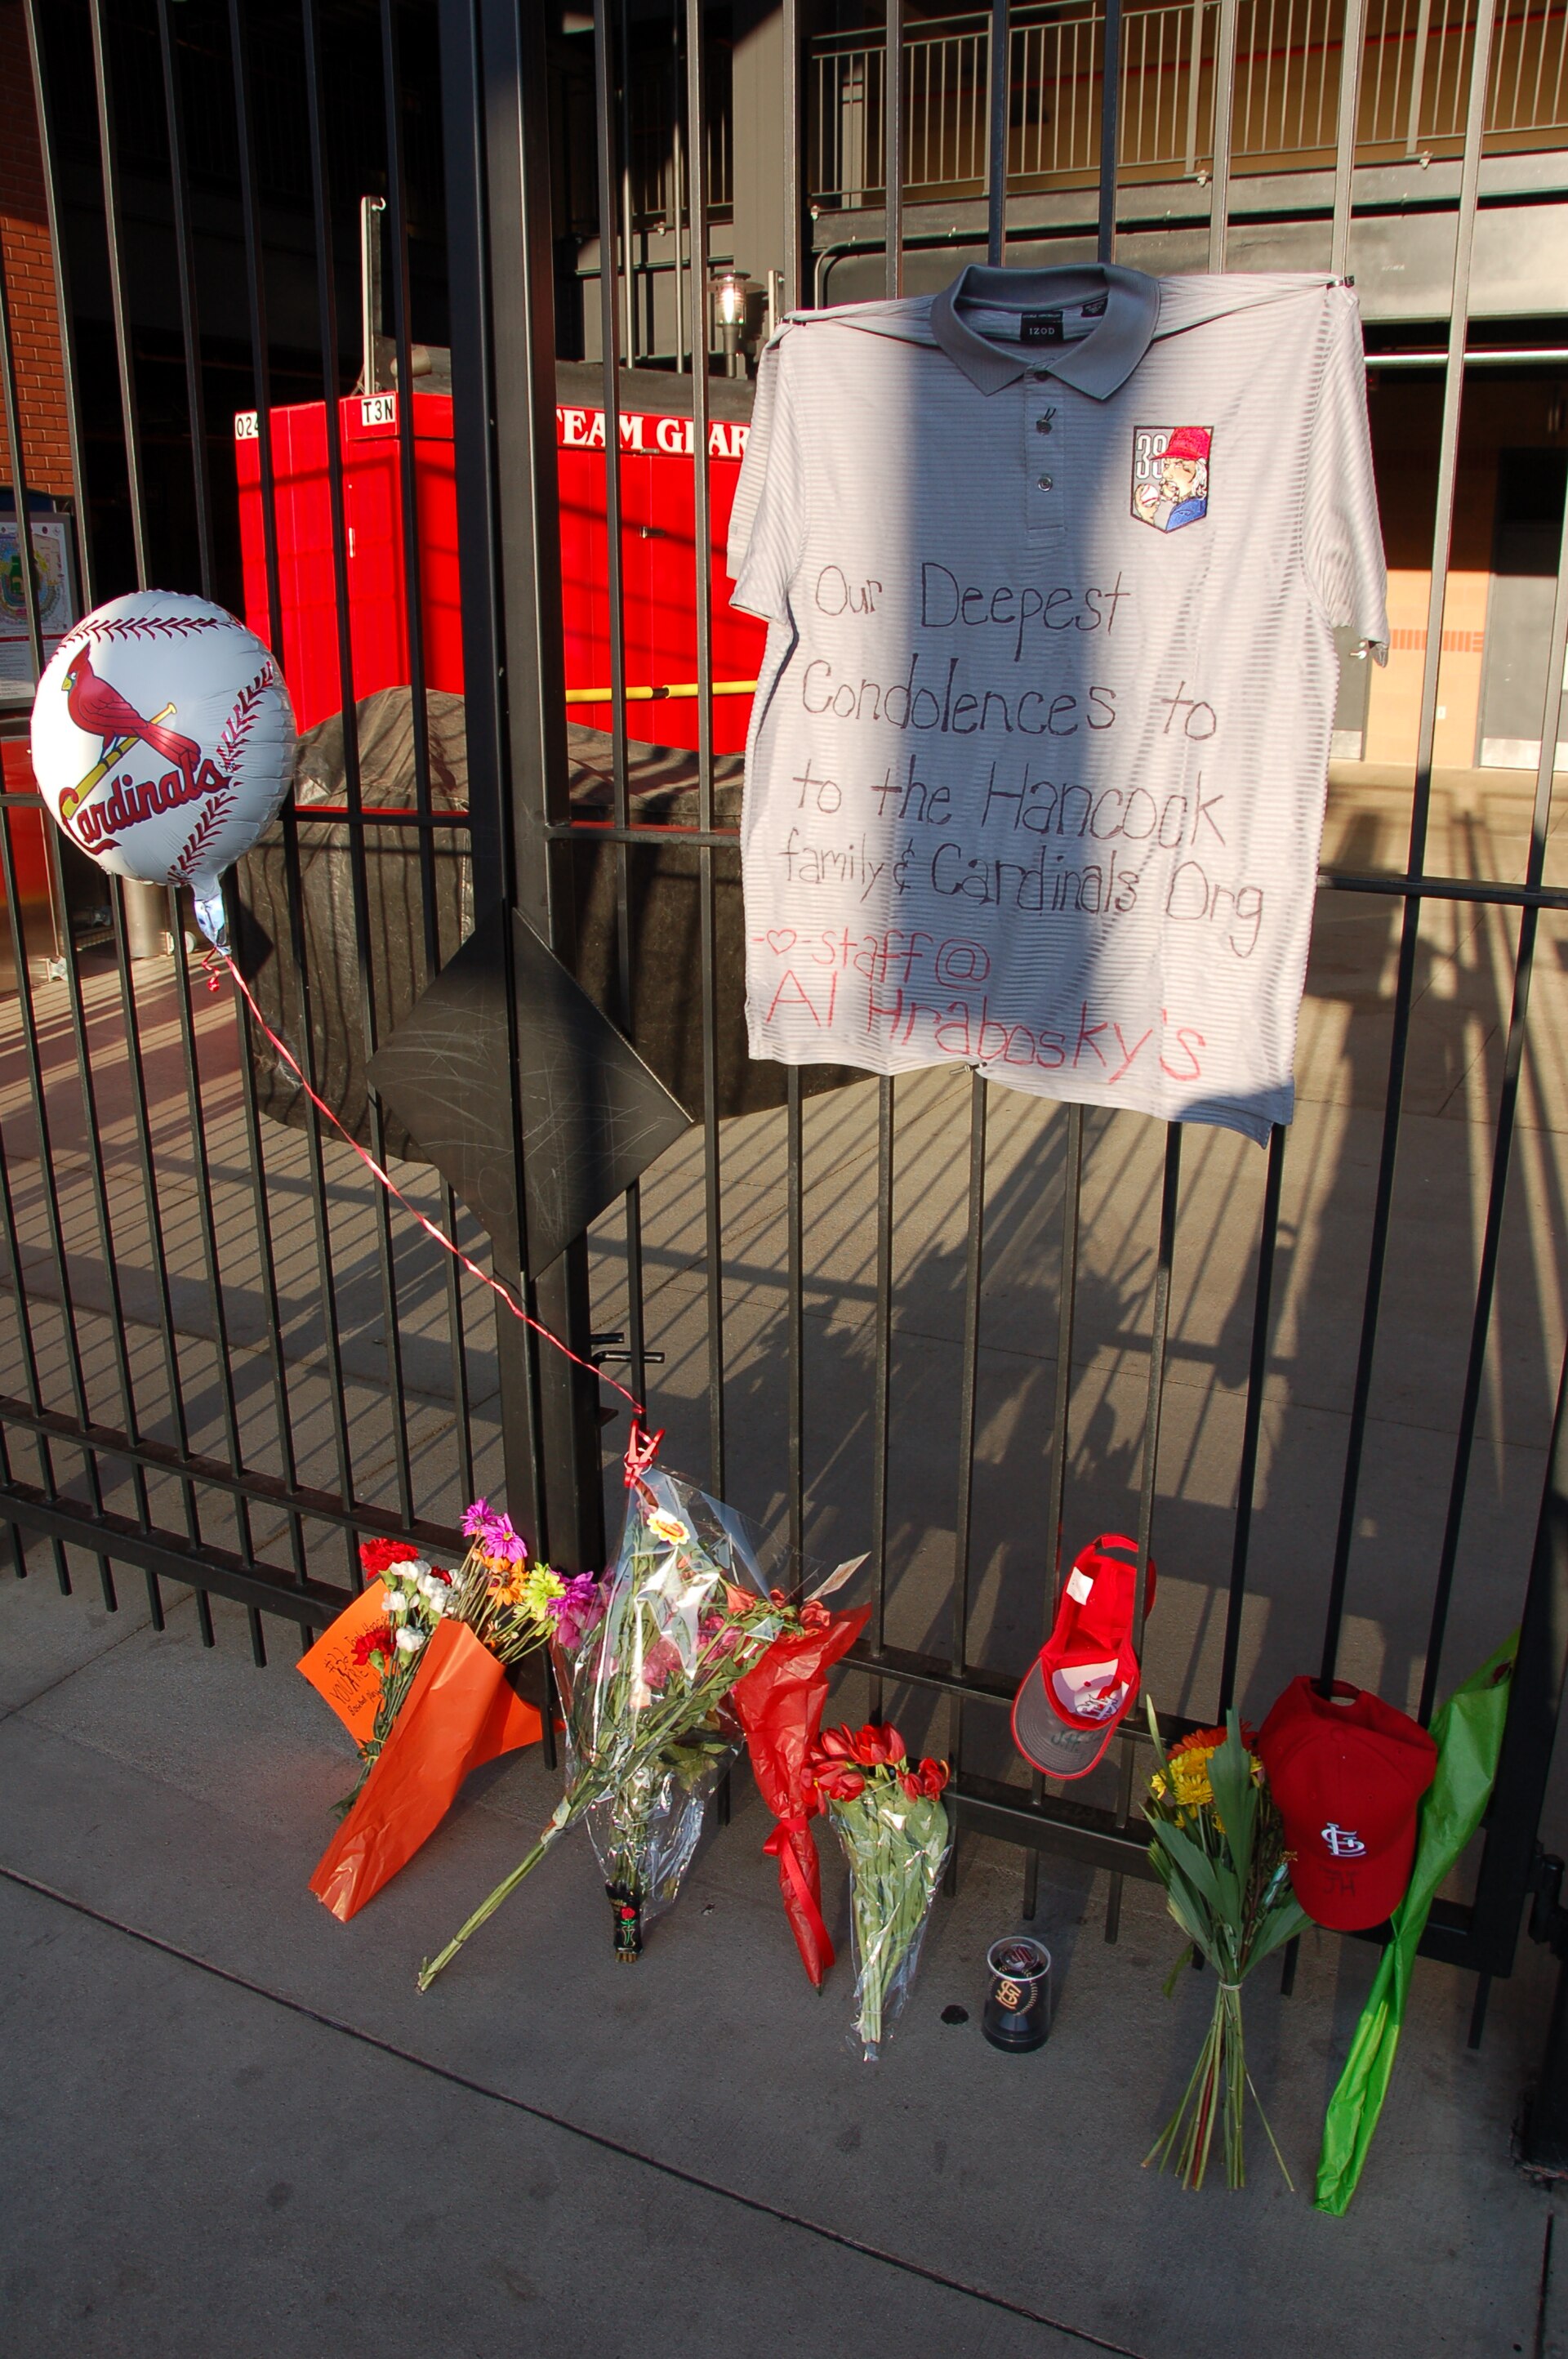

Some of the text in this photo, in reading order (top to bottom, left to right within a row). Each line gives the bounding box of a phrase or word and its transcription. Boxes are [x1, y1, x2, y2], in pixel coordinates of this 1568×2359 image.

[1029, 327, 1055, 335] IZOD
[237, 417, 259, 438] 02
[363, 395, 393, 423] T3N
[557, 408, 644, 450] EAM
[816, 562, 1131, 662] Our Deepest
[803, 653, 1217, 740] Condolences to
[59, 758, 233, 856] Cardinals
[793, 754, 1227, 850] to the Hancock
[781, 827, 885, 903] family
[932, 843, 1141, 916] Cardinals
[1165, 861, 1265, 959] Org
